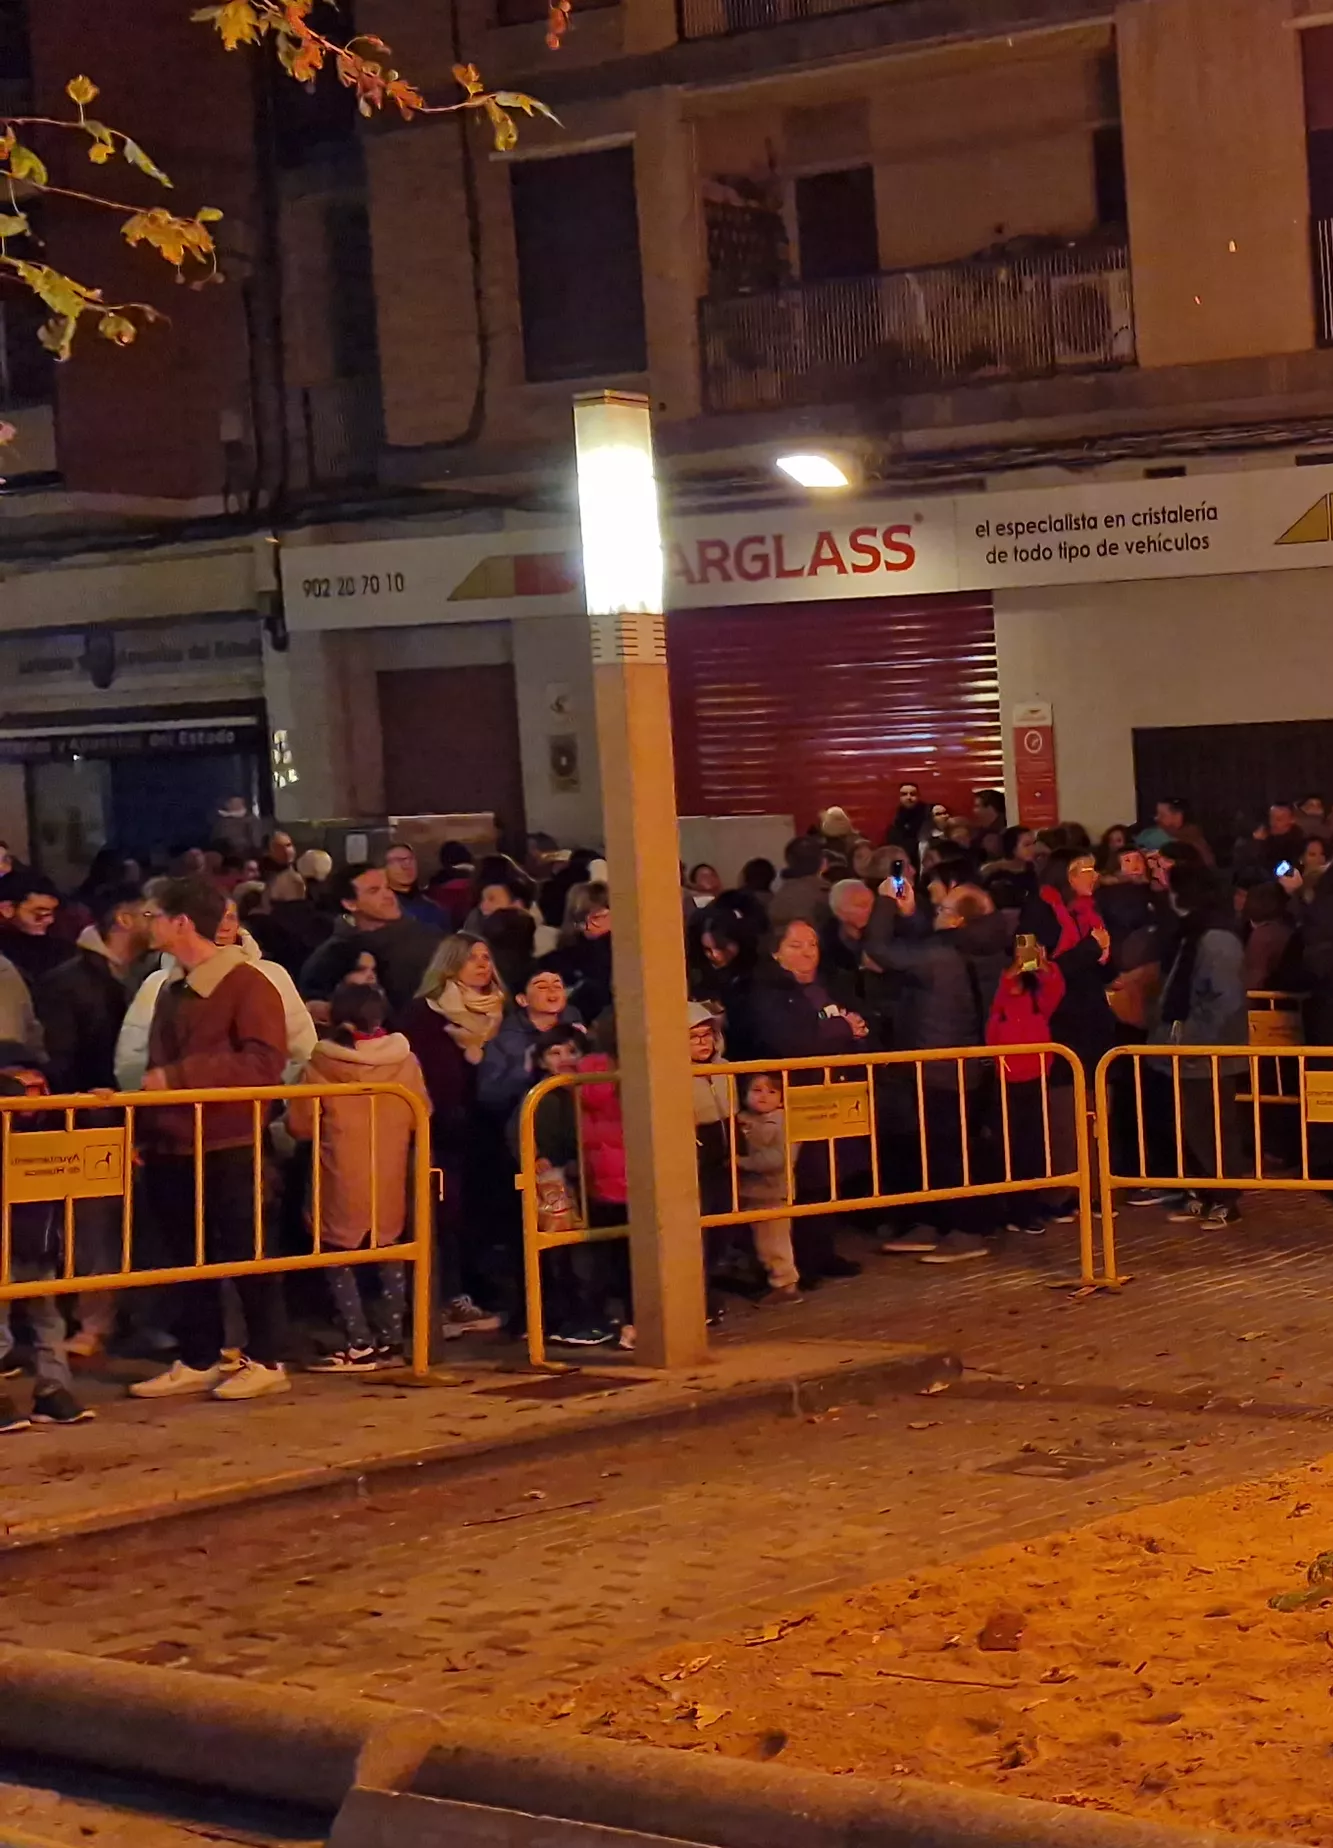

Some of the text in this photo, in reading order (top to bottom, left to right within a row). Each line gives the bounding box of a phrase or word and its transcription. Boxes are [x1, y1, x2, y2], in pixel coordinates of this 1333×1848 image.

[975, 501, 1218, 540] el especialista en cristalería
[669, 524, 917, 585] ARGLASS
[985, 532, 1210, 564] de todo tipo de vehículos
[303, 572, 404, 598] 902 20 70 10
